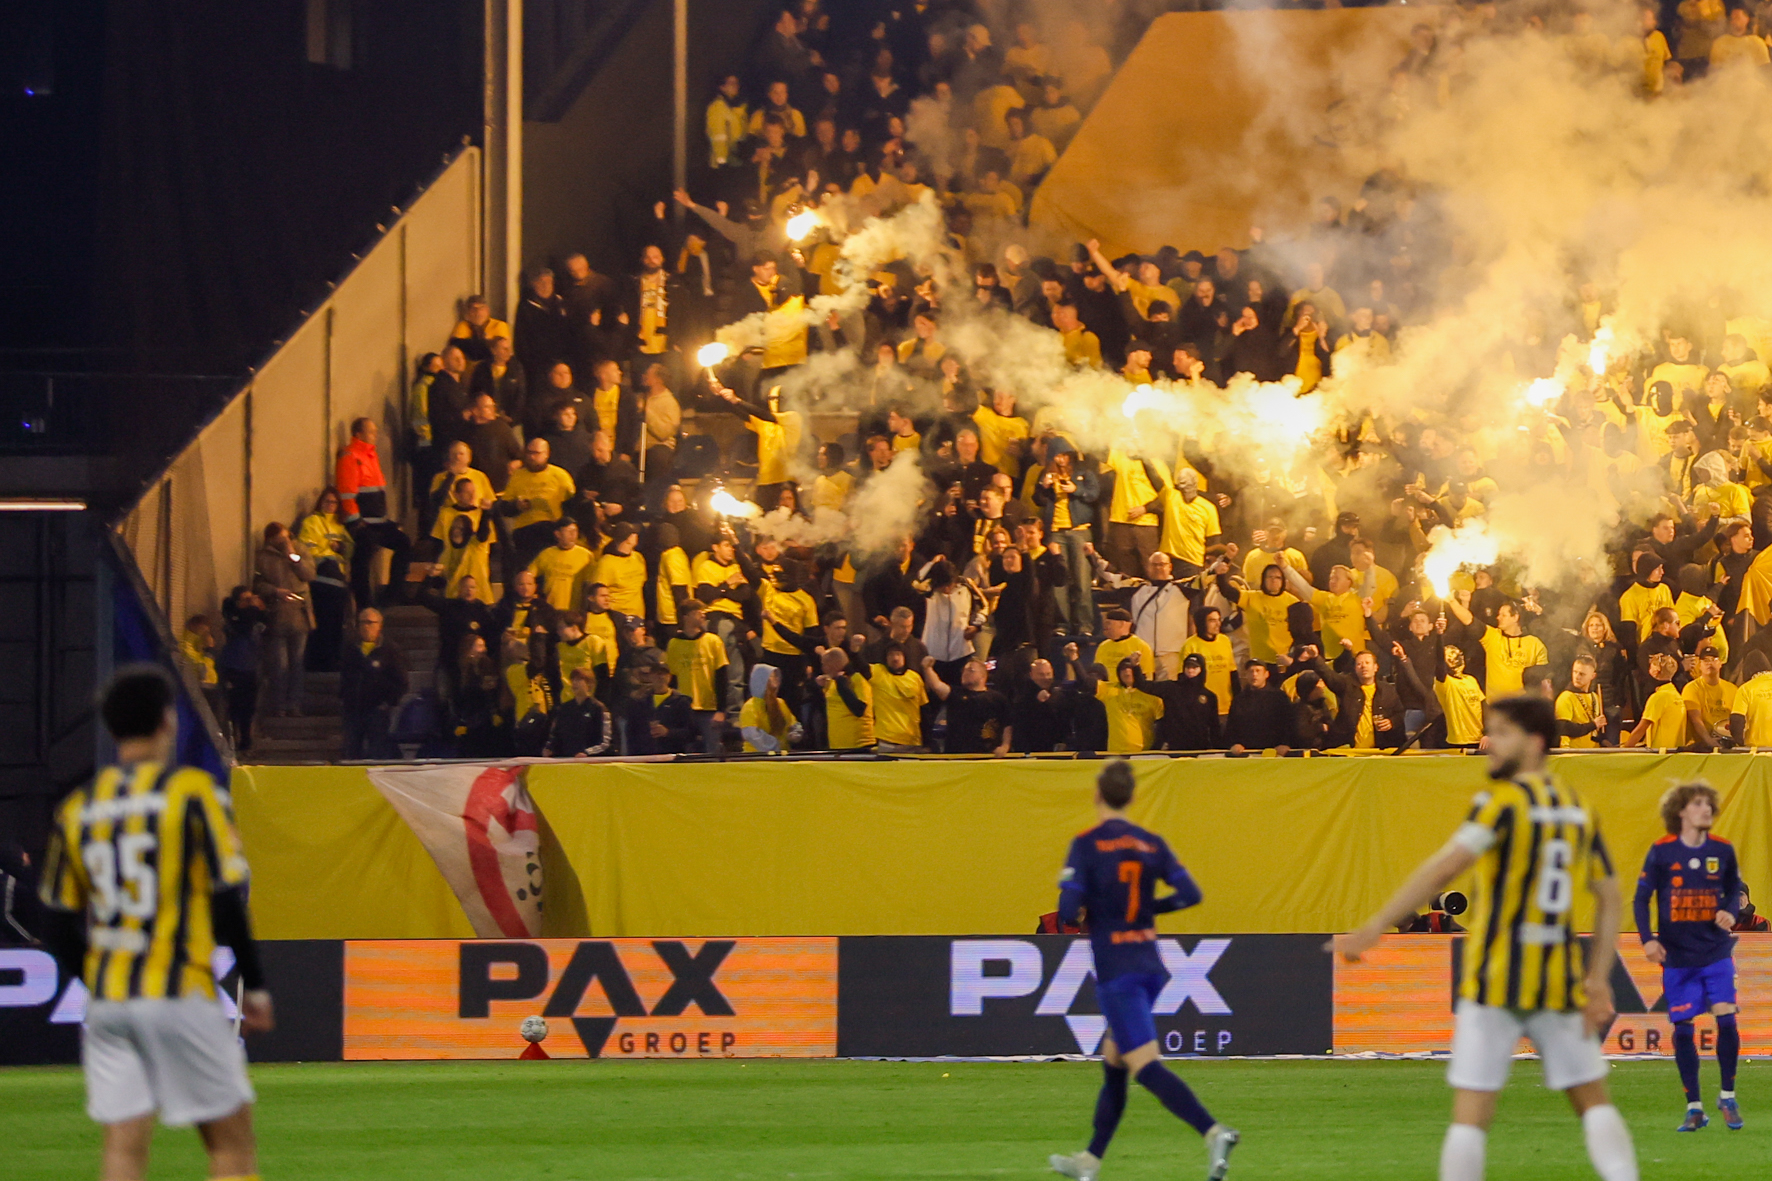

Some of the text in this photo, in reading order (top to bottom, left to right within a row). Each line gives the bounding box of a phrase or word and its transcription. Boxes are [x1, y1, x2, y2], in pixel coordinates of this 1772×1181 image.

[1117, 859, 1143, 923] 7
[1538, 838, 1573, 913] 6
[458, 941, 737, 1019] PAX
[619, 1032, 737, 1055] GROEP
[1165, 1030, 1233, 1053] OEP
[1618, 1028, 1714, 1052] GRE
